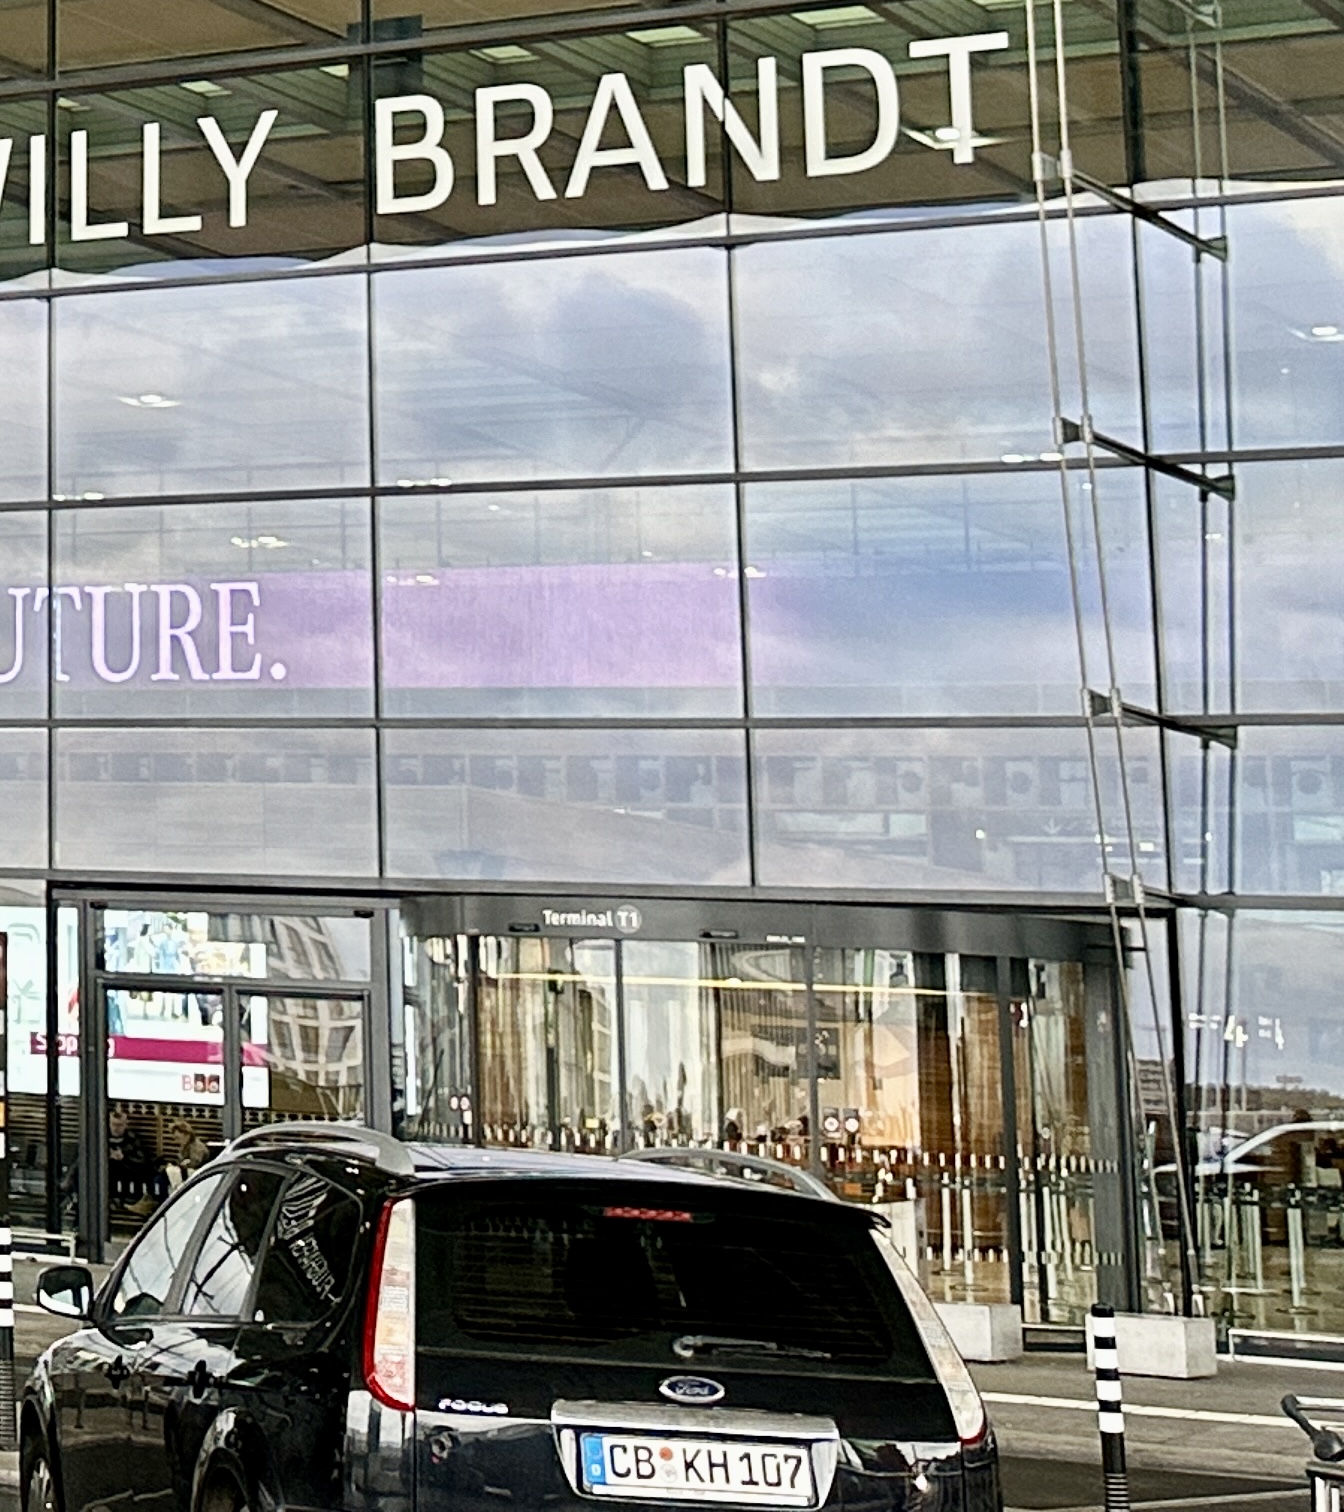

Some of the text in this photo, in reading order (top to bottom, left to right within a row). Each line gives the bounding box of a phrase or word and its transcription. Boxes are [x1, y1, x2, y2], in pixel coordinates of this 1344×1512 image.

[374, 31, 1010, 216] BRANDT
[542, 909, 638, 928] Terminal T1
[609, 1443, 656, 1480] CB
[683, 1447, 730, 1486] KH
[738, 1451, 804, 1491] 107
